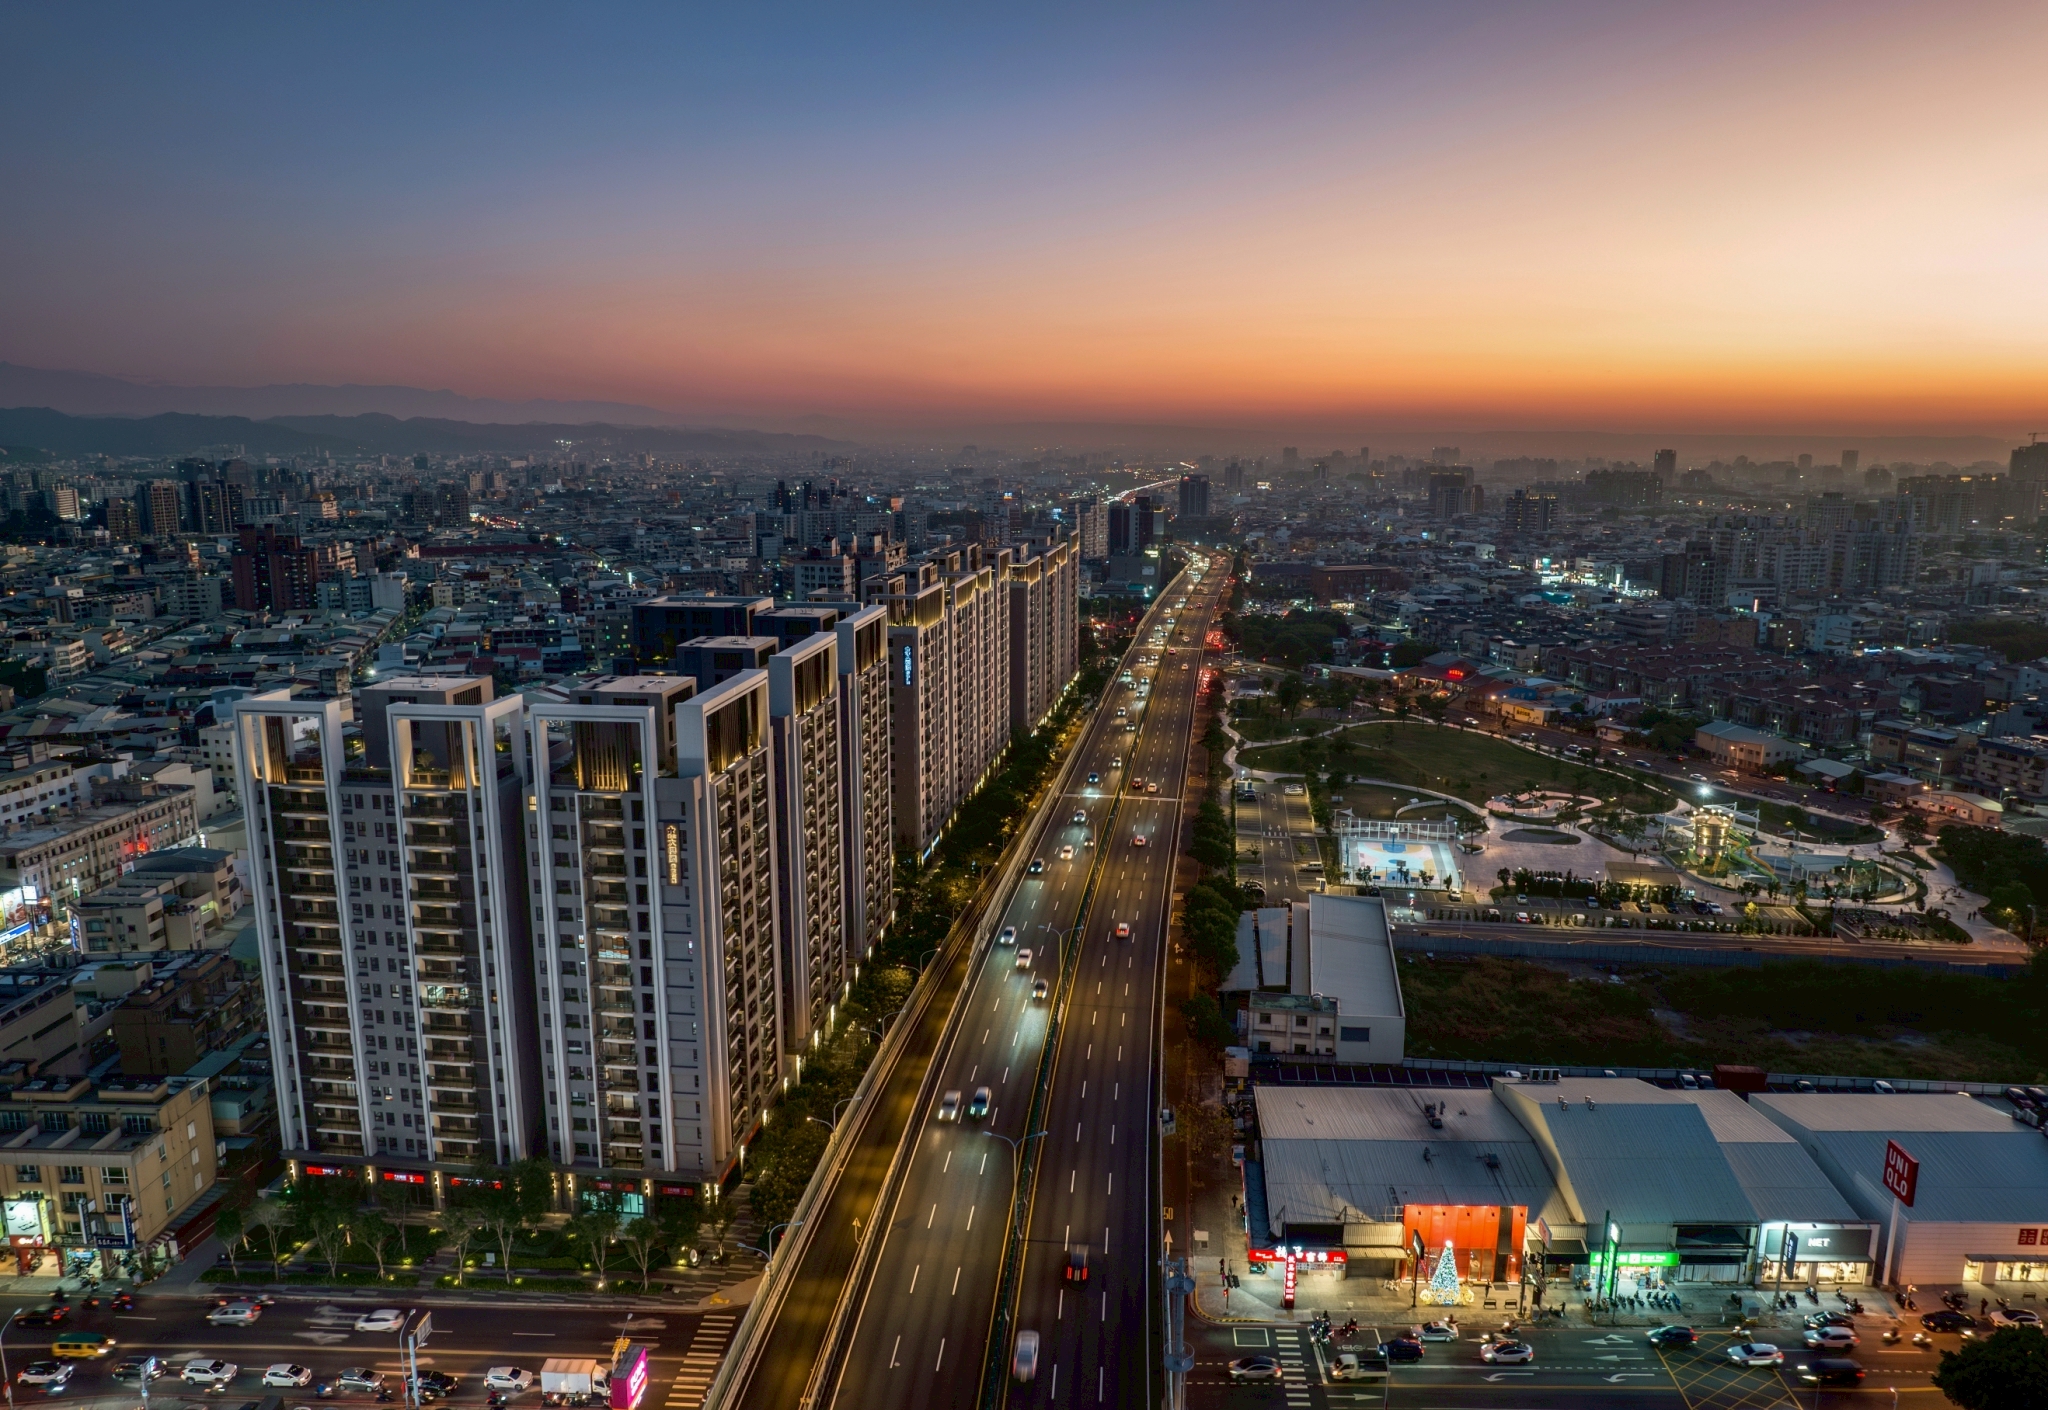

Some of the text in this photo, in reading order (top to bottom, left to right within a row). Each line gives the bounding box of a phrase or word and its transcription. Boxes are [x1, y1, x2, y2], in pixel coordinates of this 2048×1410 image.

[1889, 1148, 1908, 1177] UNI
[1886, 1167, 1908, 1196] QLO
[1163, 1206, 1174, 1220] 50
[1807, 1238, 1831, 1247] NET
